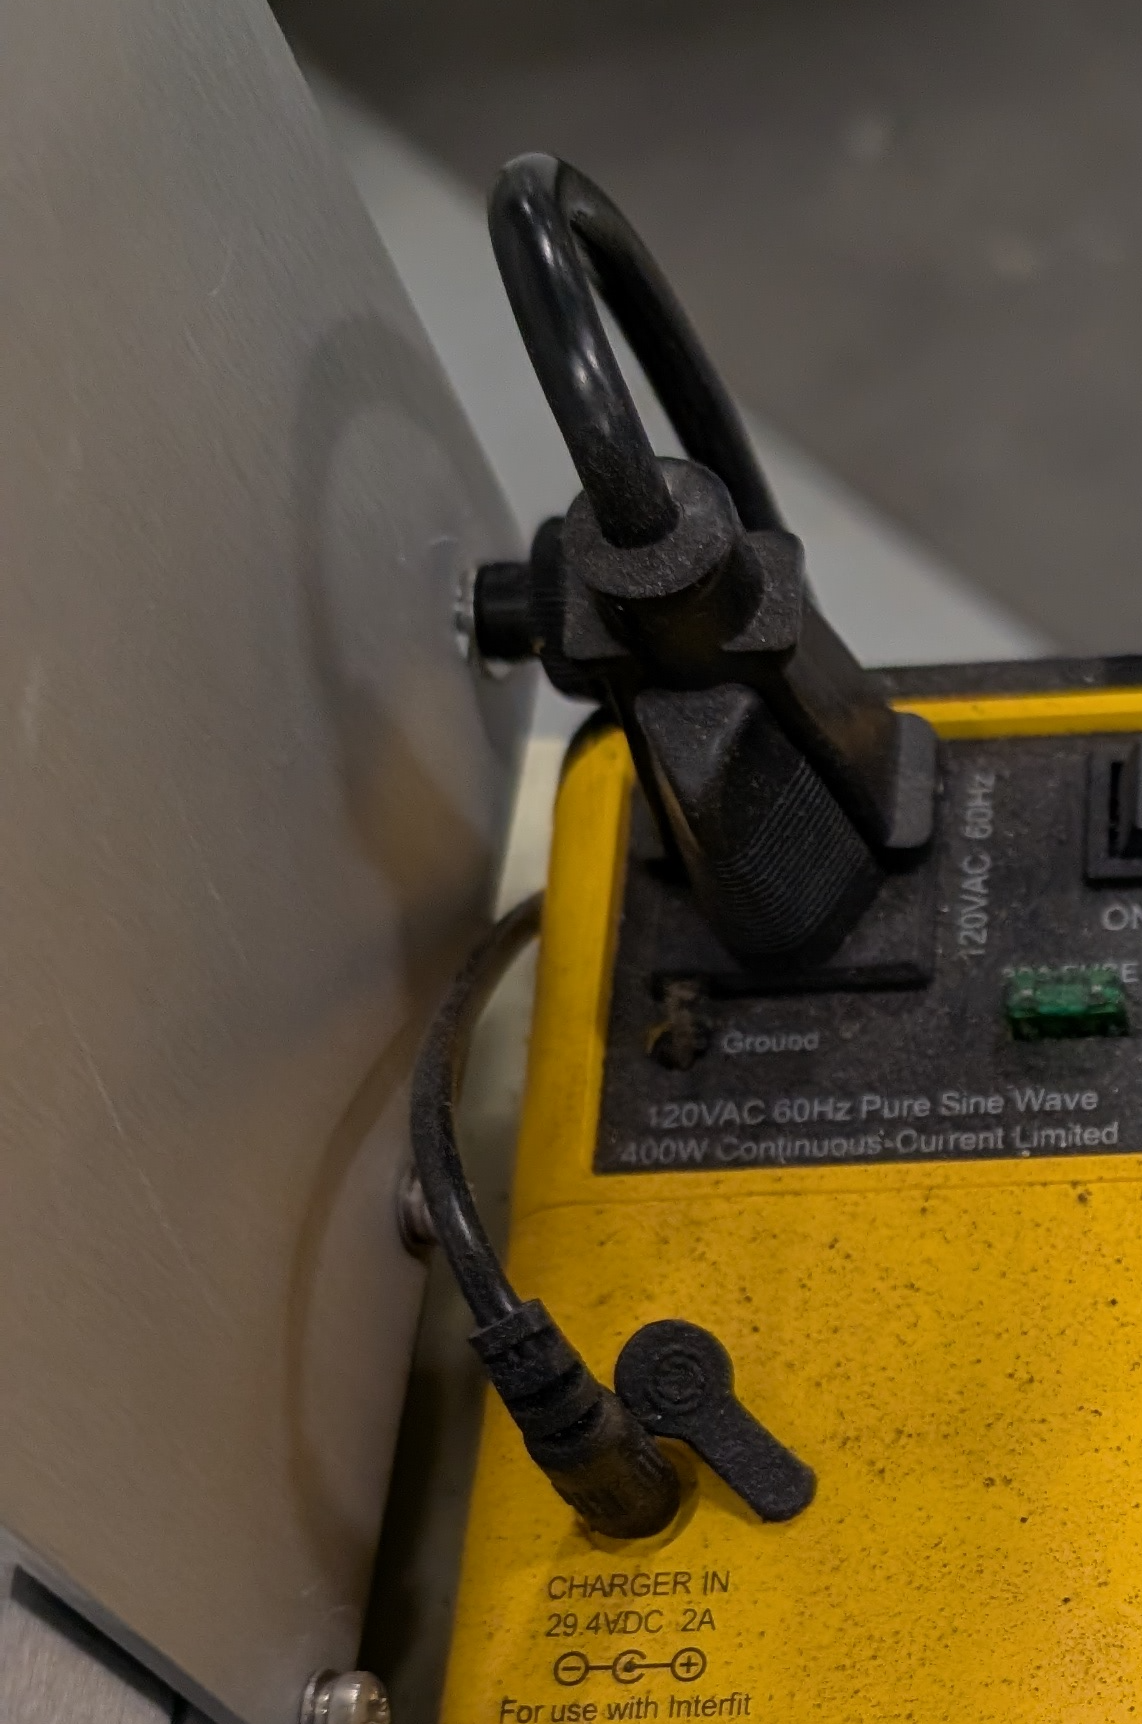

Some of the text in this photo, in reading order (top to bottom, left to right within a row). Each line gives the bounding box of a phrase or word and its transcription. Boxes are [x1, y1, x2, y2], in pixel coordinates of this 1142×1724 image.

[957, 773, 995, 958] 120VAC 60Hz
[724, 1031, 819, 1053] Ground
[650, 1086, 1099, 1129] 120VAC 60Hz Pure Sine Wave
[621, 1136, 708, 1165] 400W
[1013, 1121, 1119, 1149] Limited
[548, 1570, 731, 1600] CHARGER IN
[546, 1607, 717, 1638] 29.4VDC 2A
[500, 1692, 752, 1724] For use with Interfit
